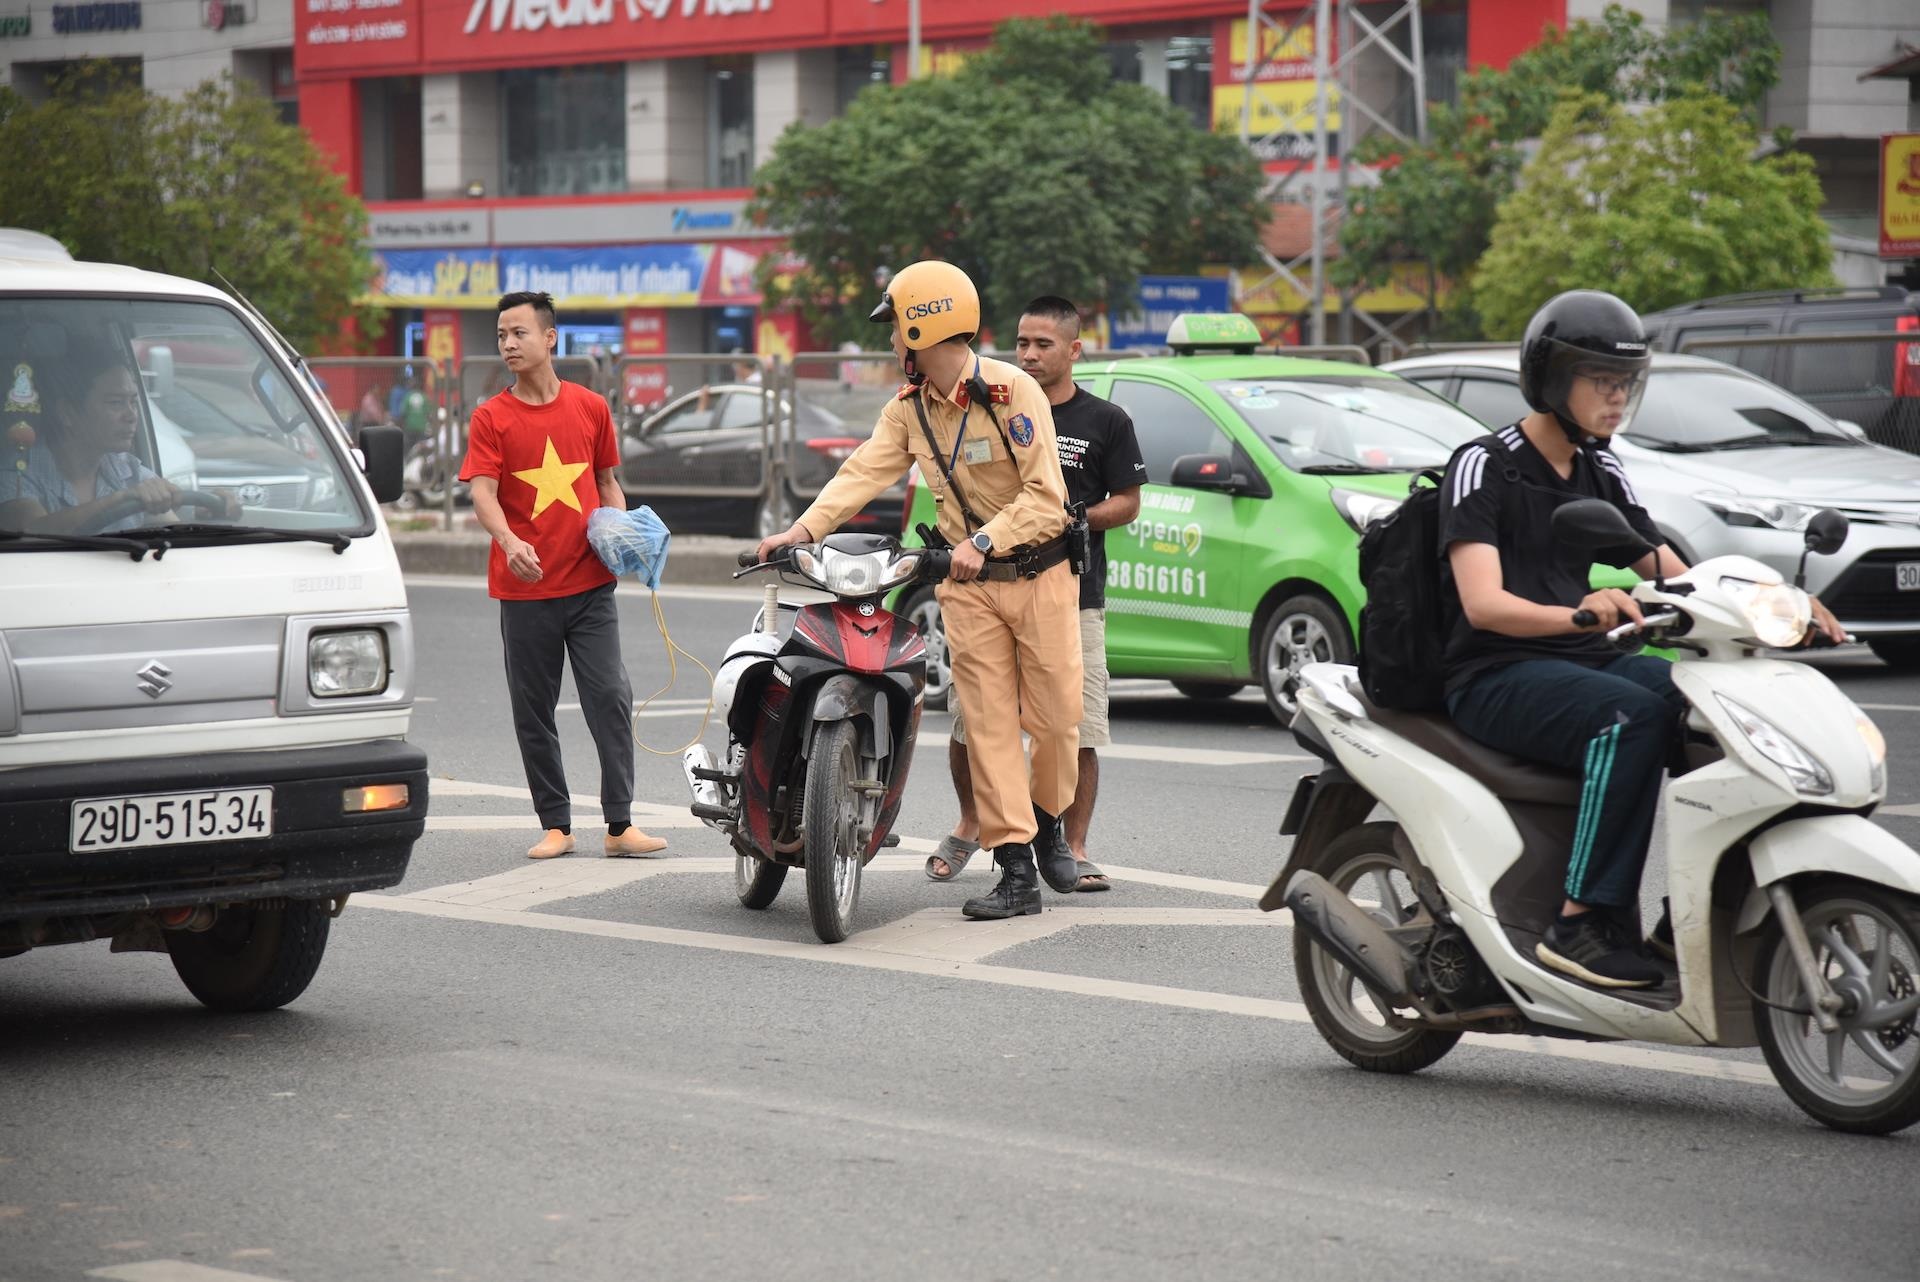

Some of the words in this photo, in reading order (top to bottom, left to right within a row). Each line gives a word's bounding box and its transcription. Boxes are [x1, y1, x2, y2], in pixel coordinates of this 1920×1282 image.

[906, 298, 953, 320] CSGT
[1899, 567, 1920, 586] 30
[773, 664, 792, 688] YAMAHA
[78, 795, 265, 846] 29D-515.34
